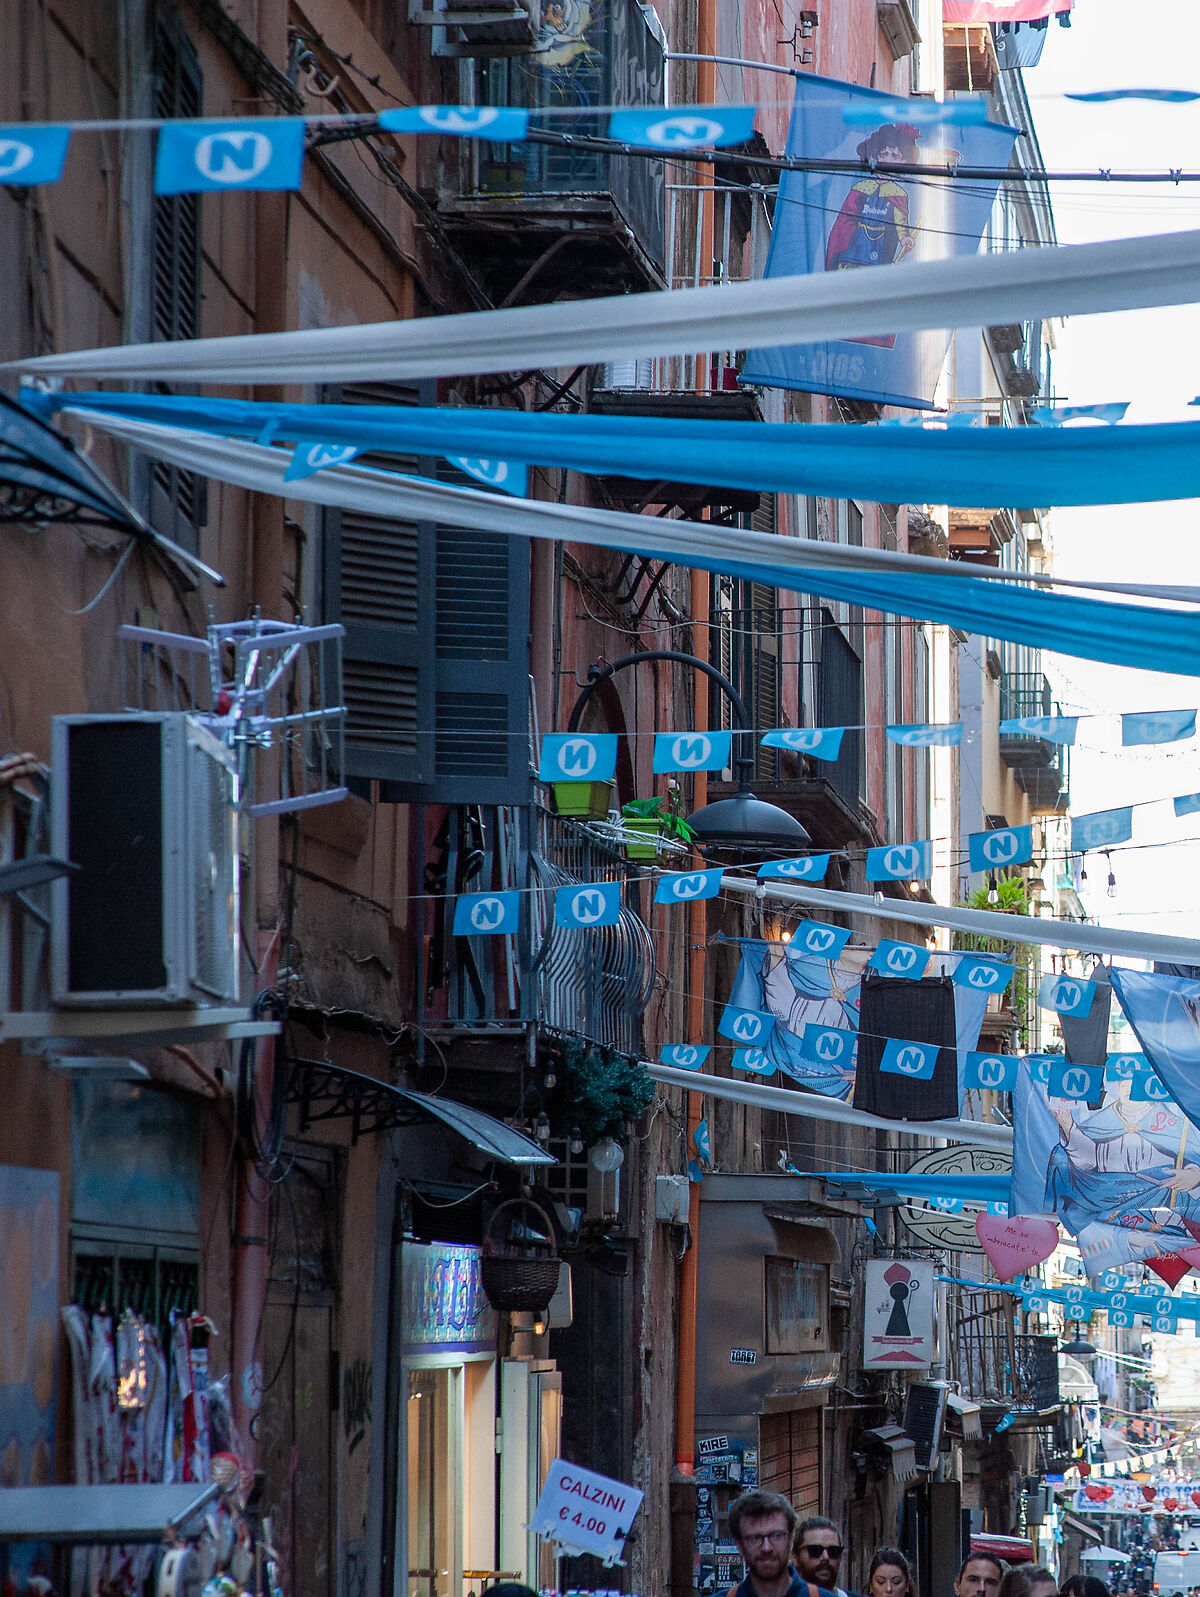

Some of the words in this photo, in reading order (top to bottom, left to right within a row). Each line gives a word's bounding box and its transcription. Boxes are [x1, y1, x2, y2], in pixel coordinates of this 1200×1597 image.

[655, 120, 715, 145] N
[205, 136, 263, 177] N
[312, 444, 347, 464] N
[987, 835, 1014, 860] N
[782, 860, 807, 872] N
[888, 848, 916, 873] N
[677, 877, 703, 894] N
[475, 902, 501, 926] N
[576, 894, 602, 919] N
[809, 931, 832, 949] N
[890, 949, 913, 968] N
[972, 968, 995, 985] N
[1055, 985, 1078, 1008] N
[736, 1017, 758, 1037] N
[819, 1035, 841, 1058] N
[899, 1049, 922, 1070] N
[981, 1061, 1002, 1083] N
[1065, 1070, 1087, 1093] N
[1149, 1078, 1167, 1095] N
[700, 1438, 728, 1452] KIRE
[559, 1476, 626, 1512] CALZINI
[559, 1506, 570, 1520] €
[572, 1512, 606, 1535] 4.00
